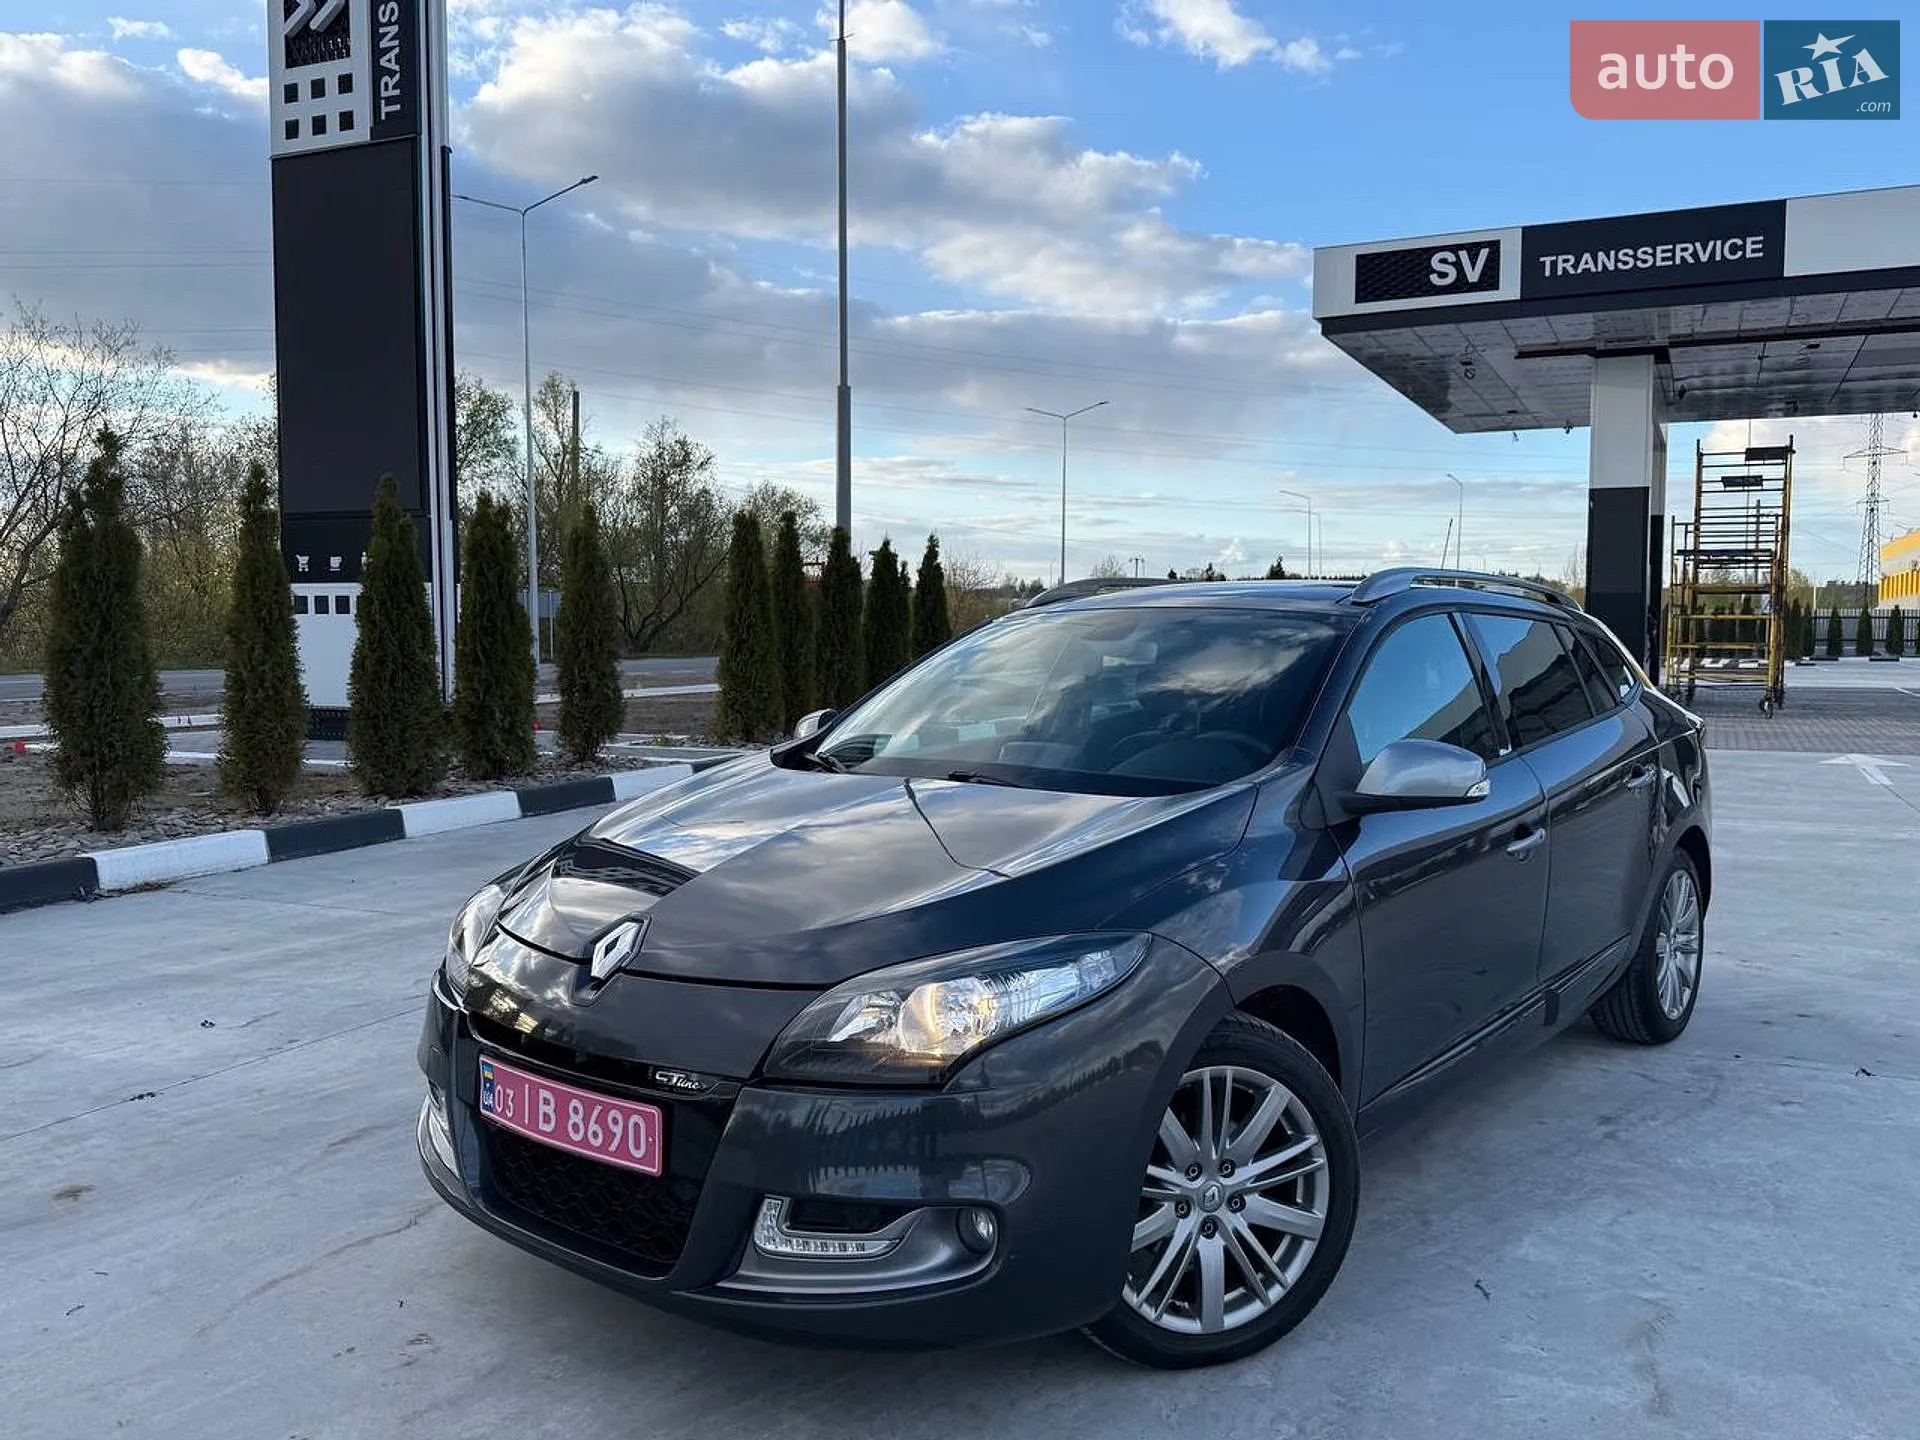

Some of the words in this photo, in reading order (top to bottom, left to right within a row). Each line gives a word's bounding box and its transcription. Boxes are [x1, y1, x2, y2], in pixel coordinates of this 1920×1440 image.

[378, 1, 401, 120] TRANS
[1429, 248, 1490, 286] SV
[1539, 235, 1764, 277] TRANSSERVICE
[495, 1084, 514, 1118] 03
[567, 1098, 647, 1159] 8690
